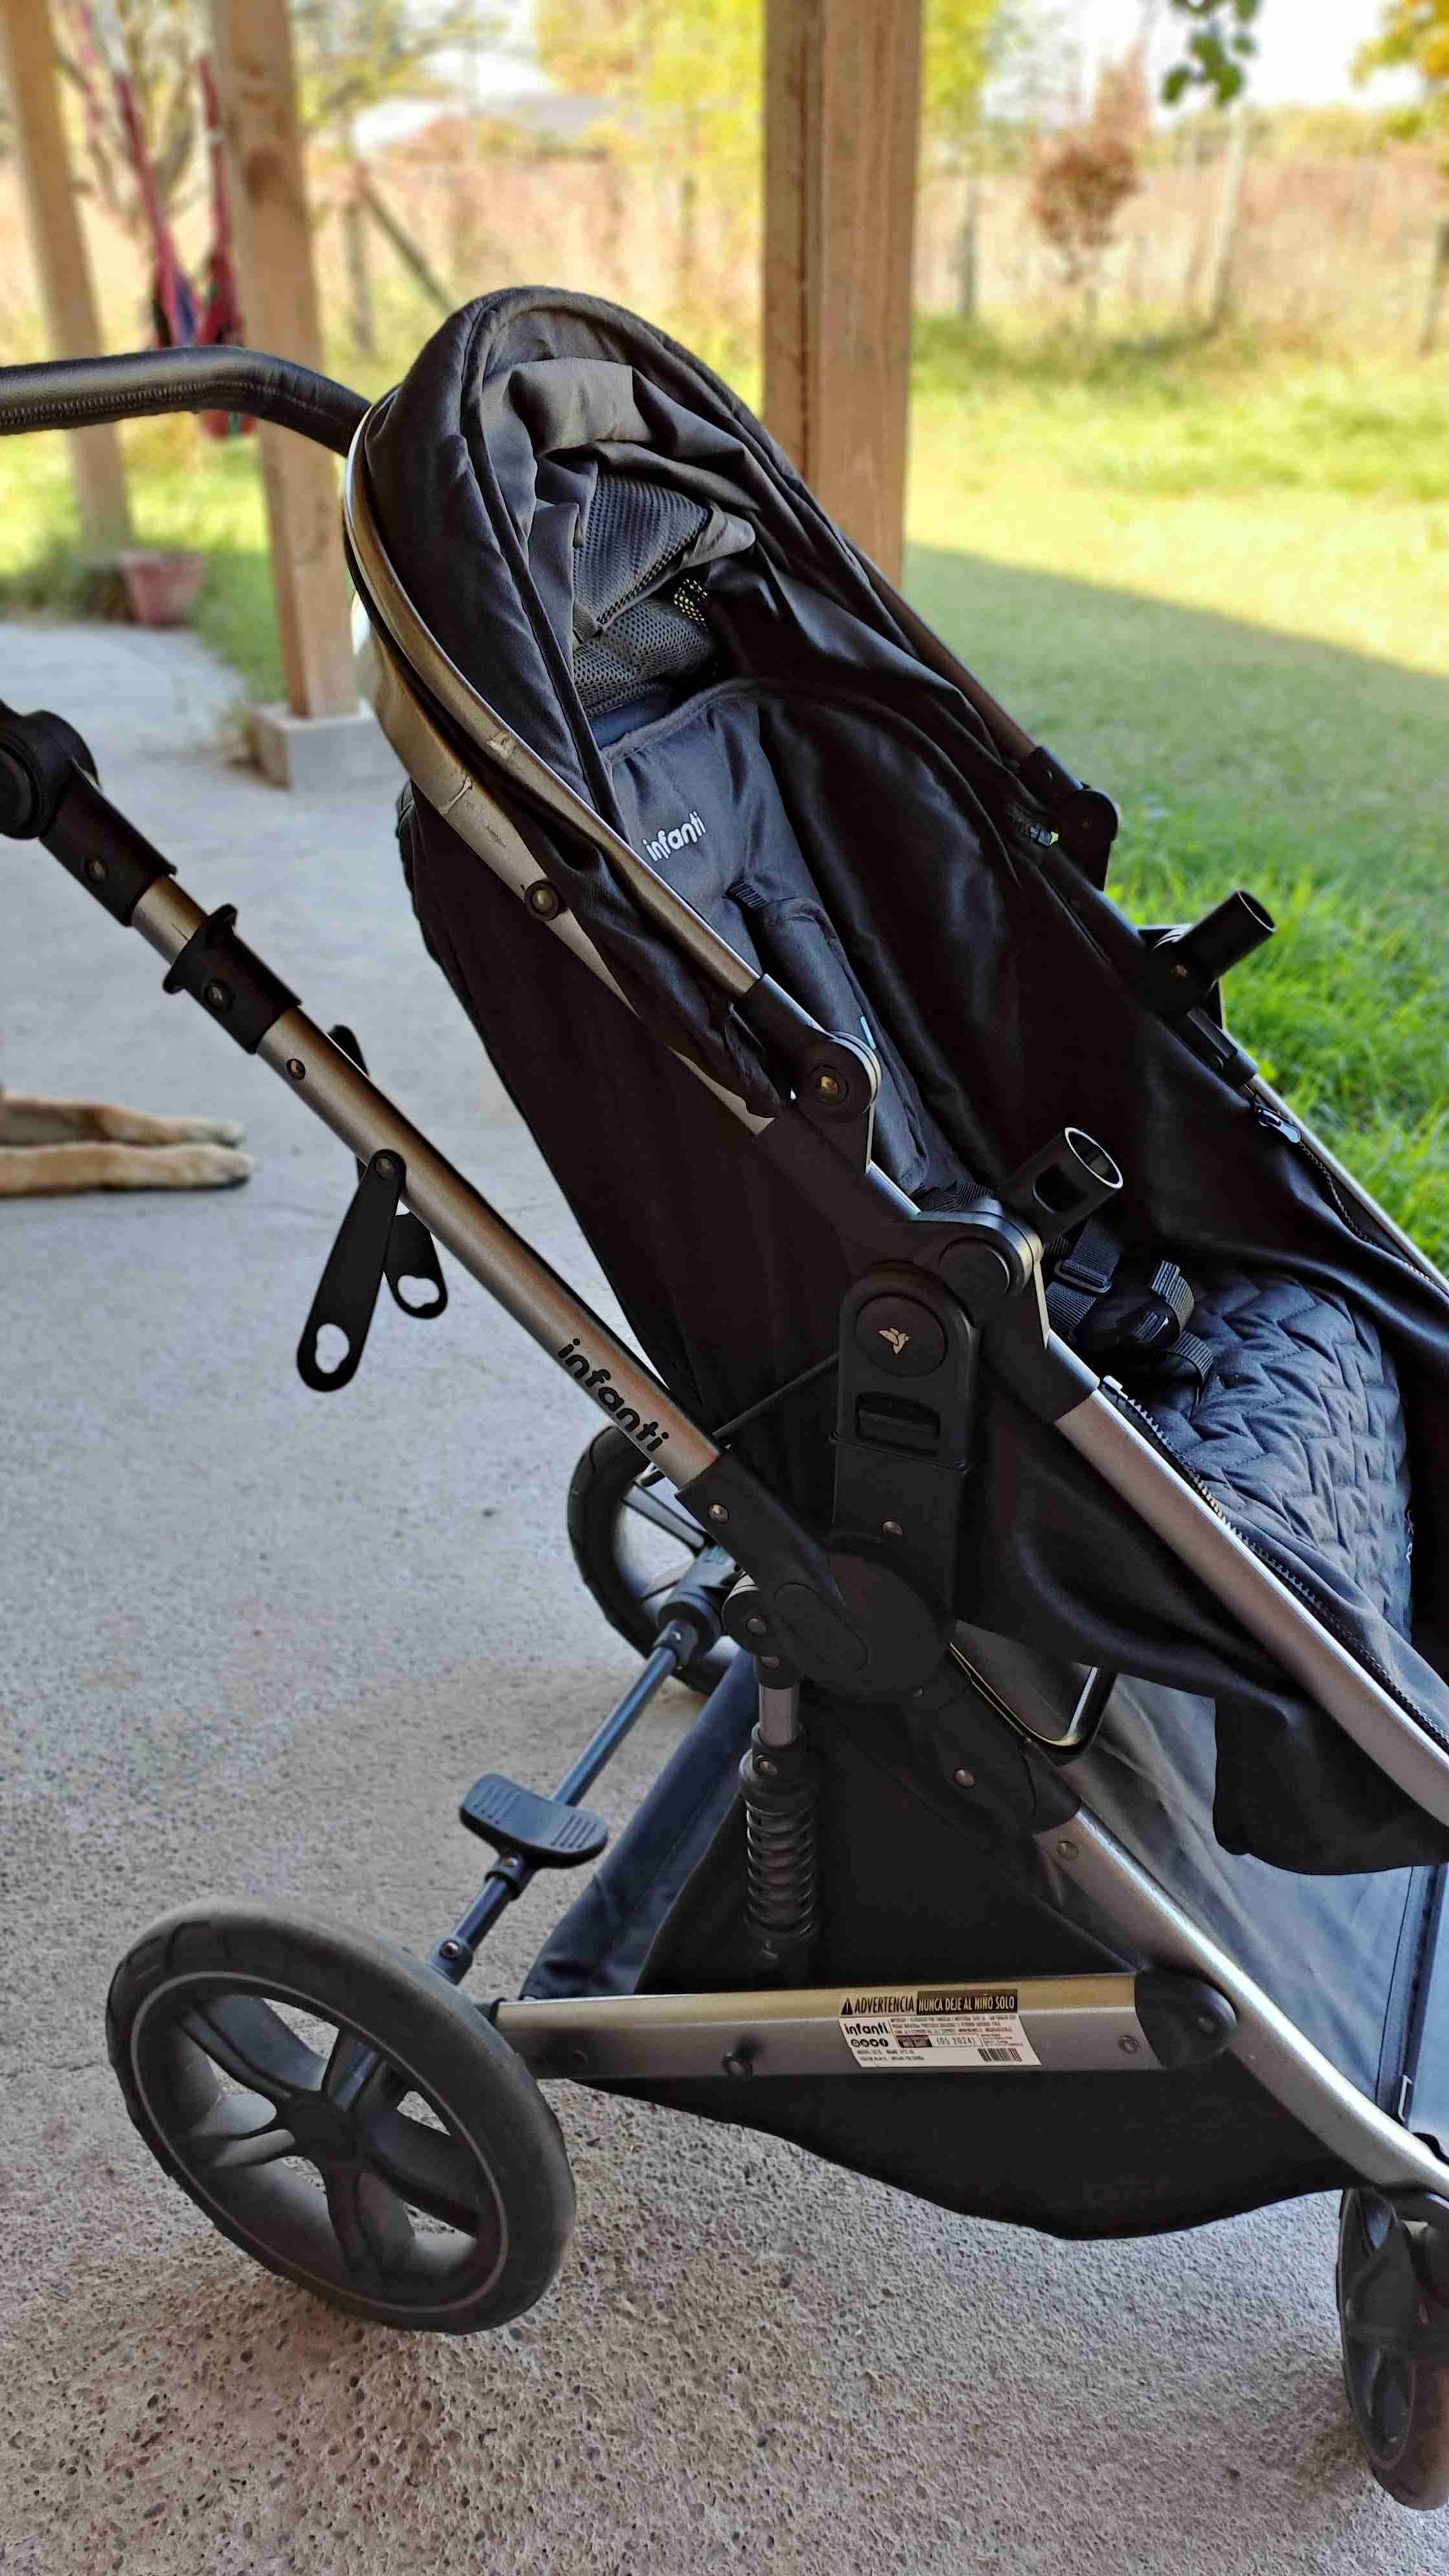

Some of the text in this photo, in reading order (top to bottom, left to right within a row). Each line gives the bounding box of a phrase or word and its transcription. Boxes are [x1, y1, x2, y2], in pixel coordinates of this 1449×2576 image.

[643, 811, 706, 861] infanti
[558, 1338, 669, 1452] infanti
[855, 1995, 914, 2013] ADVERTENCIA
[919, 1998, 943, 2011] NUNCA
[945, 1998, 961, 2010] DEJE
[963, 1996, 972, 2010] AL
[995, 1996, 1014, 2009] SOLO
